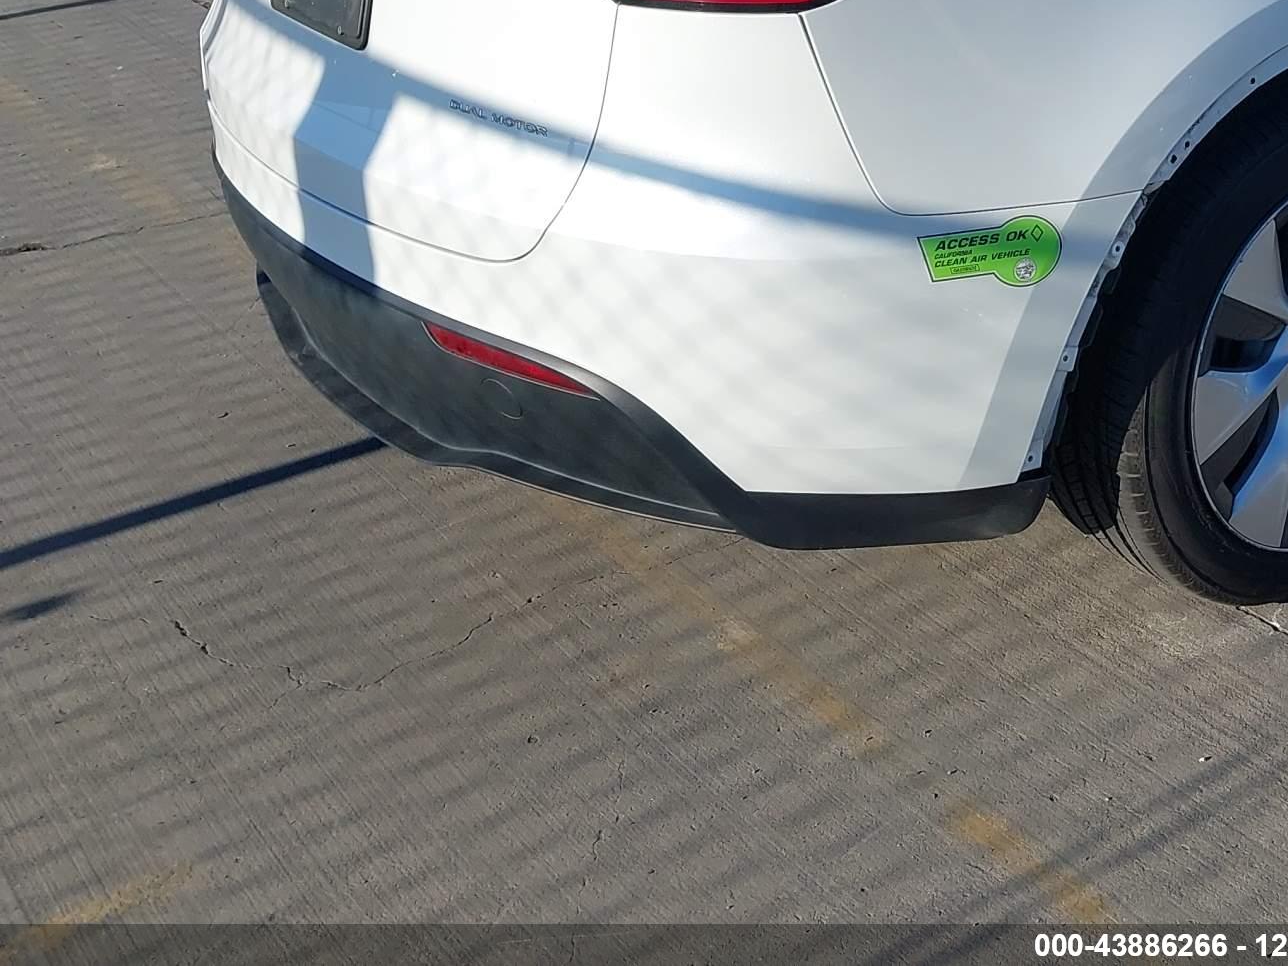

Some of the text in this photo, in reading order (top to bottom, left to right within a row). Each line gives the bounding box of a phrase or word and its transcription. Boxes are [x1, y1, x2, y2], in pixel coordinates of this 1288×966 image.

[449, 99, 548, 137] DUAL MOTOR
[934, 229, 1030, 251] ACCESS OK
[934, 250, 973, 260] CALIFORNIA
[934, 248, 1031, 268] CLEAN AIR VEHICLE
